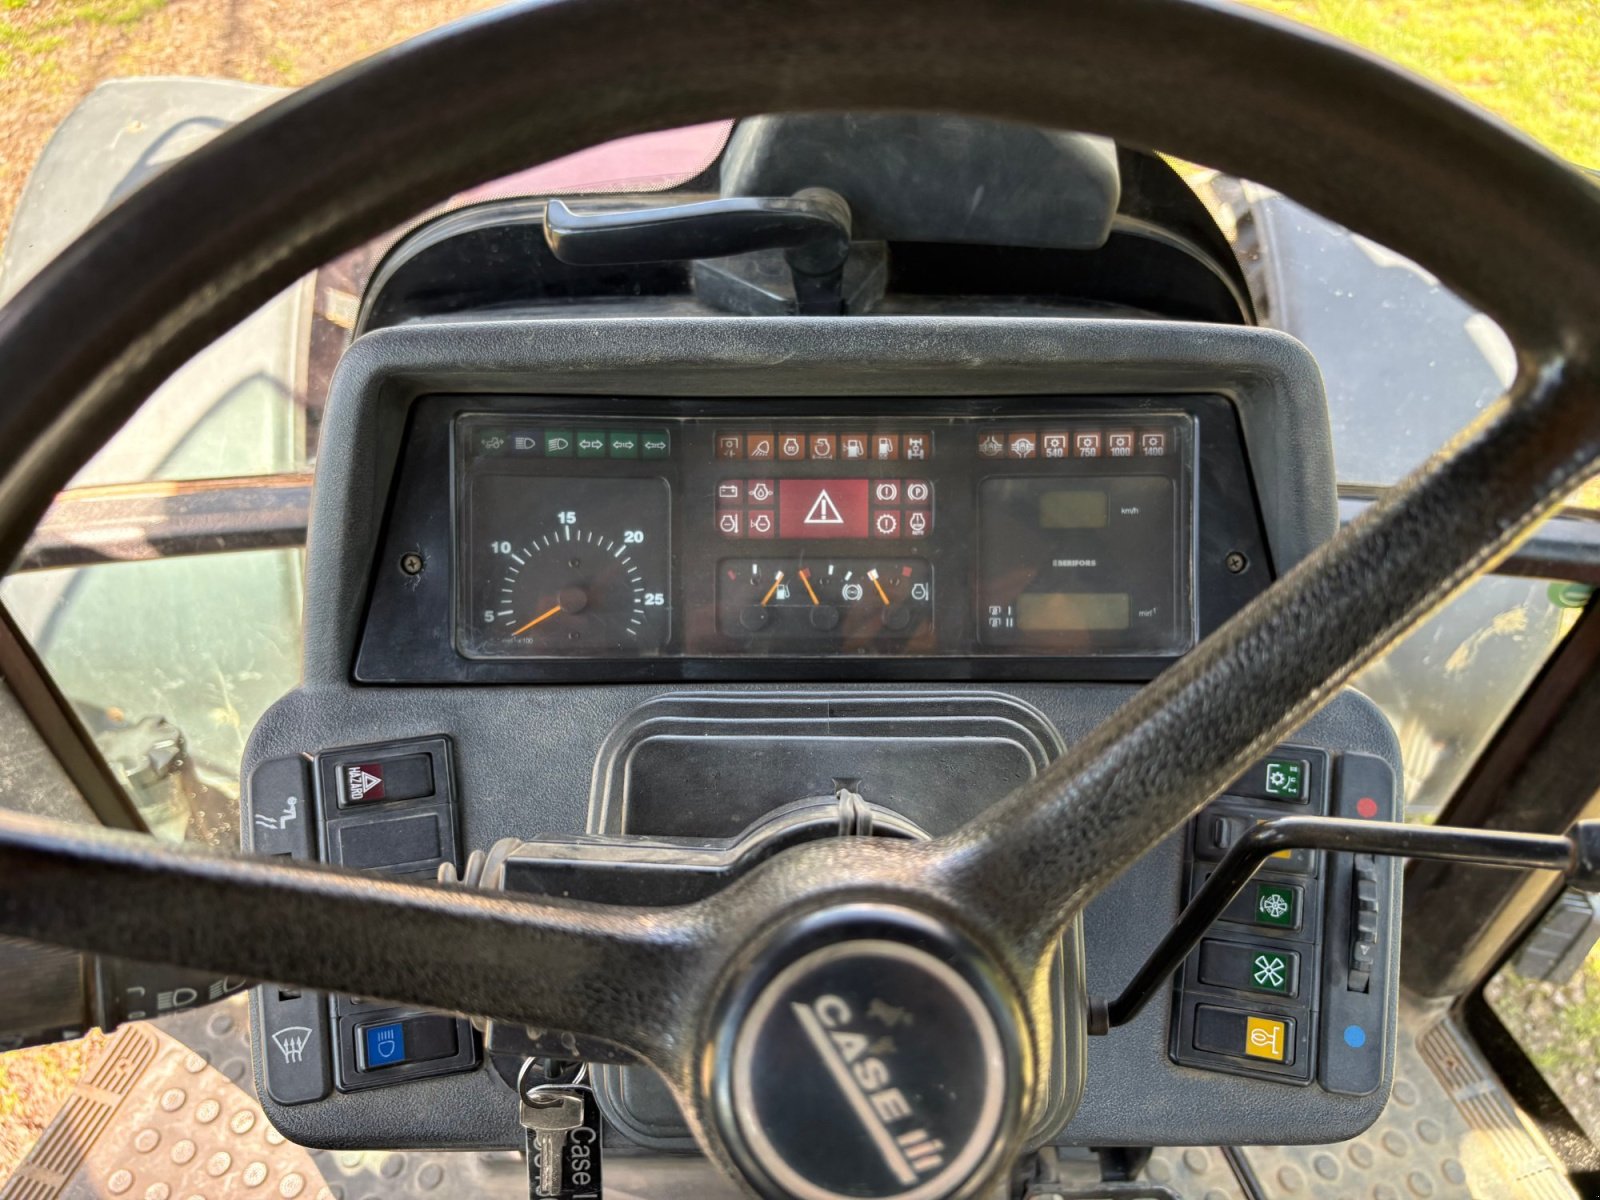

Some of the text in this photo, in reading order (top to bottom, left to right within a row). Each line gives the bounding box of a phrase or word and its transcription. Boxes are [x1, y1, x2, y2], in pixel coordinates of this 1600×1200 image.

[1046, 448, 1064, 458] 540
[1080, 448, 1097, 458] 750
[1111, 447, 1131, 457] 1000
[1121, 507, 1139, 515] km/h
[557, 512, 576, 524] 15
[624, 531, 644, 543] 20
[491, 541, 511, 554] 10
[645, 593, 664, 606] 25
[484, 611, 495, 622] 5
[349, 766, 364, 800] HAZARD
[814, 994, 912, 1122] CASE
[570, 1126, 597, 1185] Case
